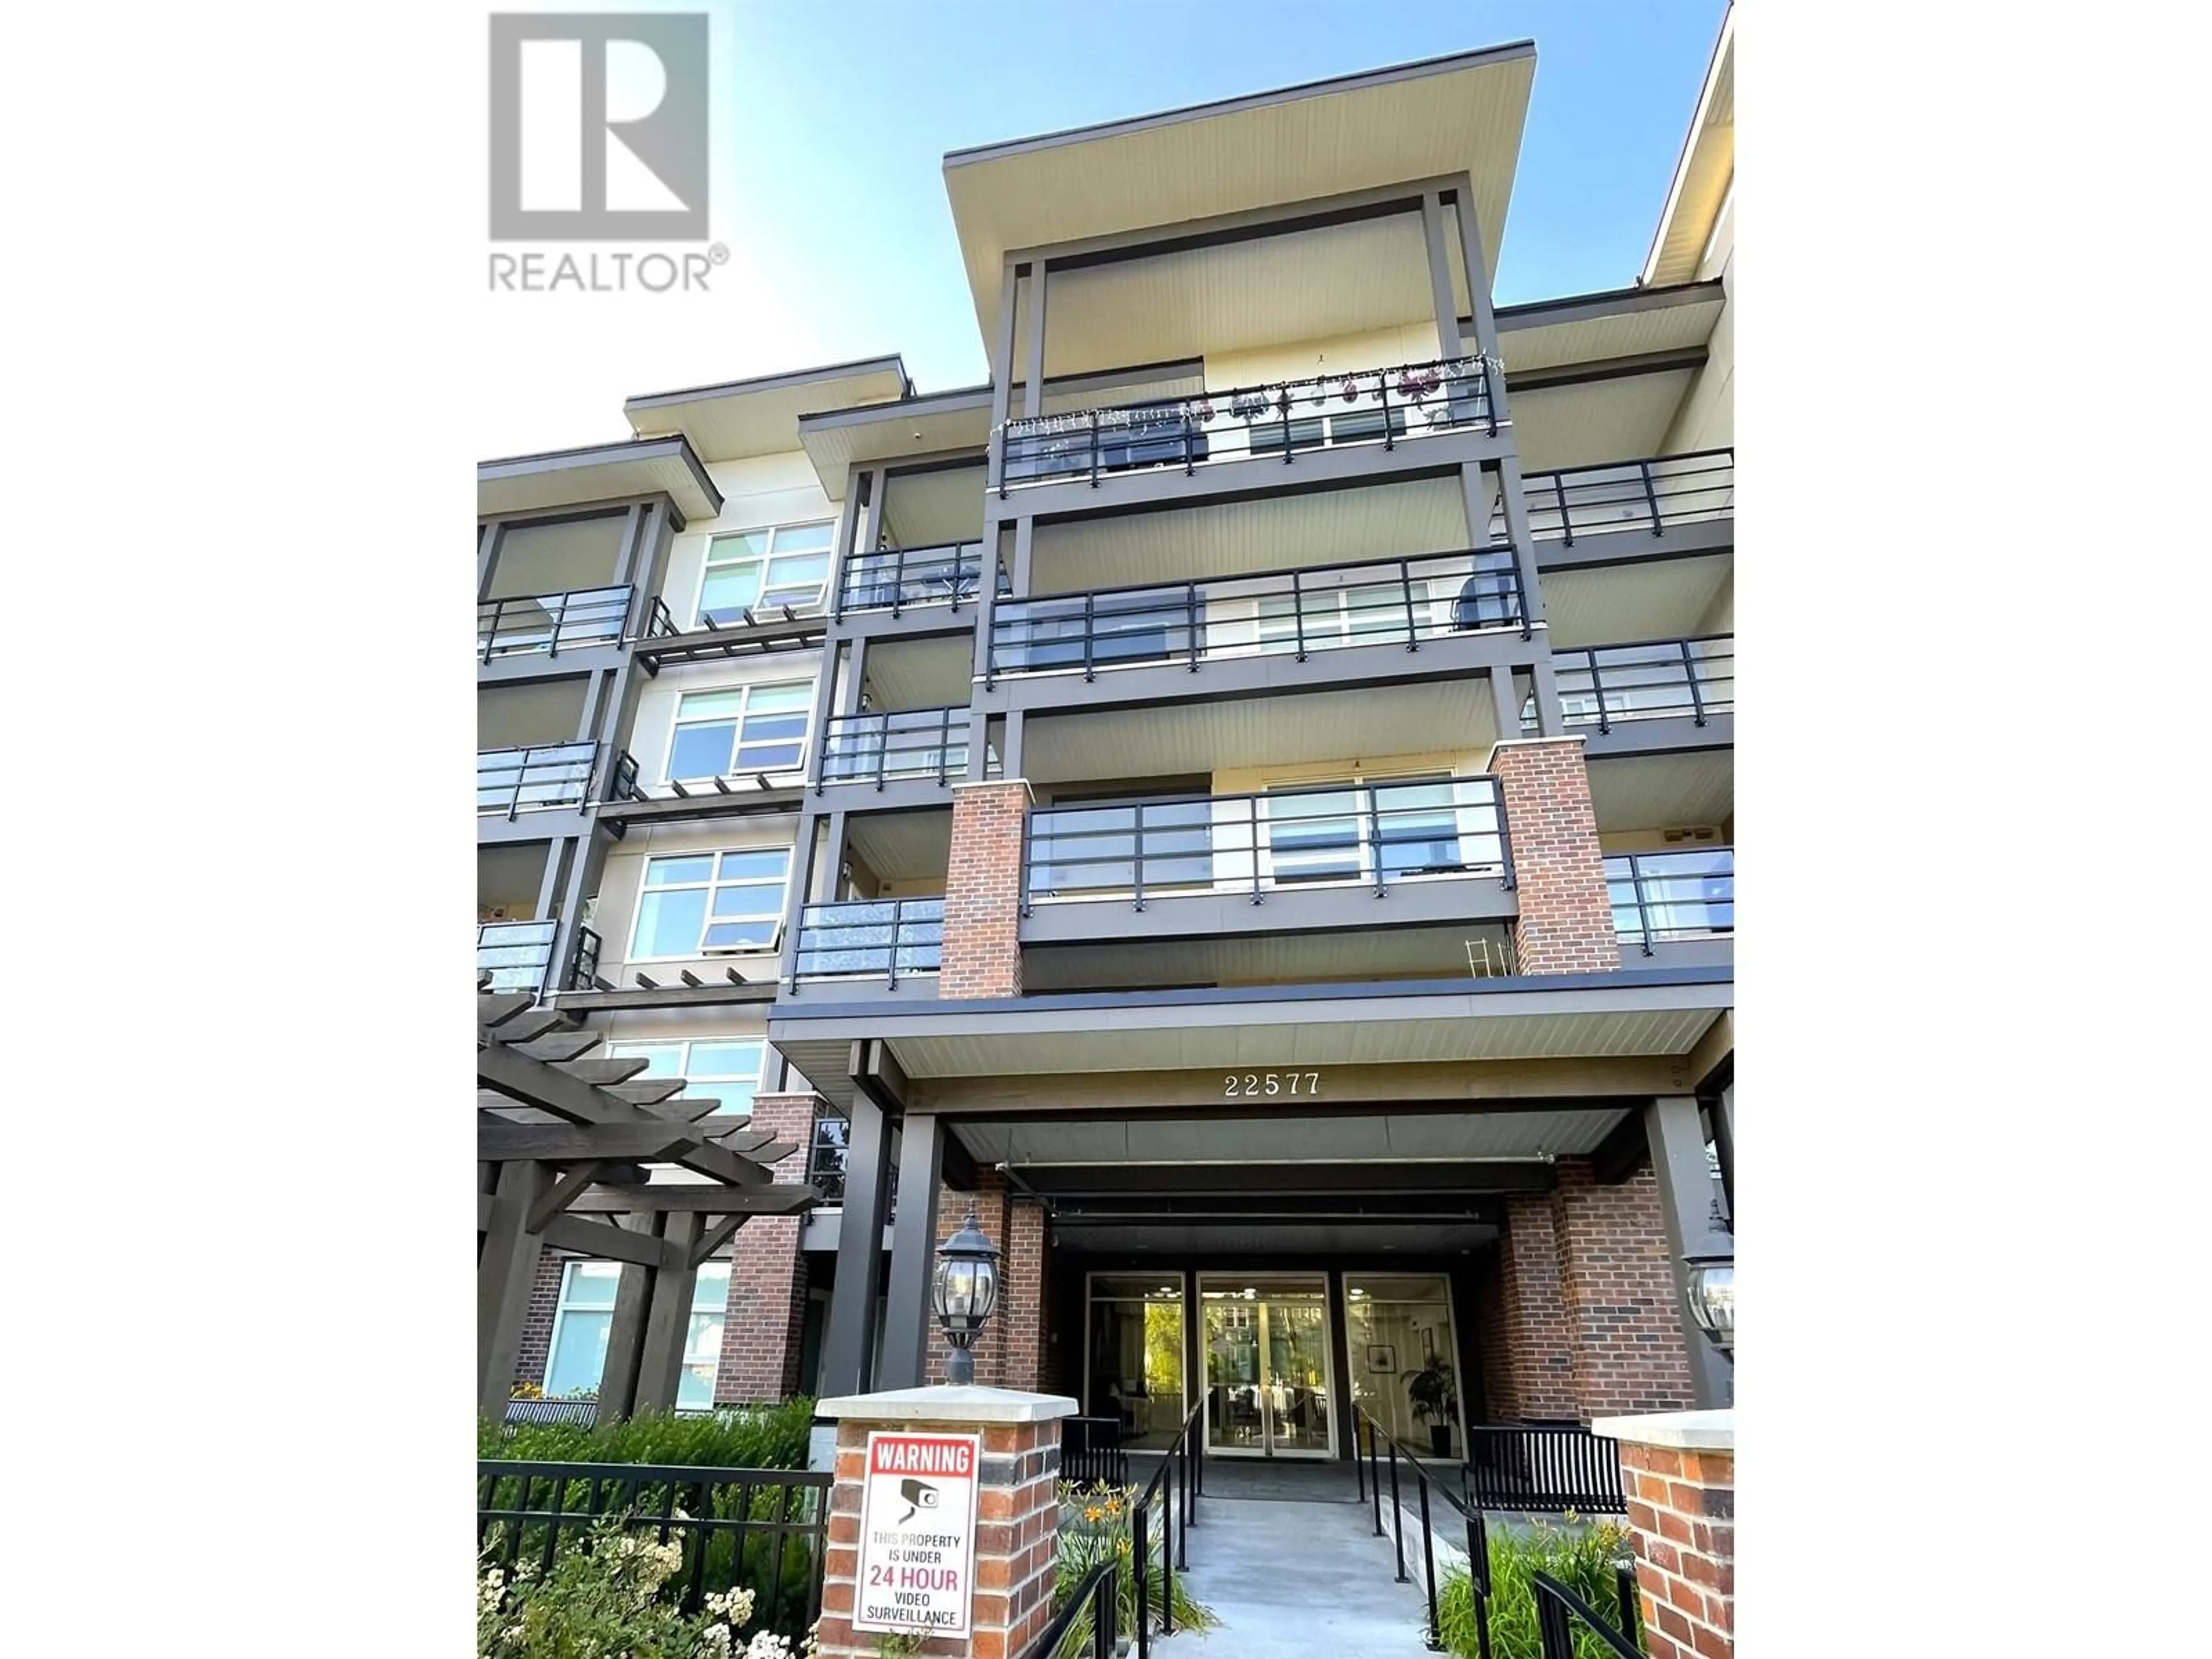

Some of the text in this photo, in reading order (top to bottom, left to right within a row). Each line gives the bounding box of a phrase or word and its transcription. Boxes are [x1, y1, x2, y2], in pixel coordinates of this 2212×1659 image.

[1225, 1073, 1319, 1096] 22577
[876, 1442, 970, 1472] WARNING
[873, 1531, 961, 1548] THIS PROPERTY
[889, 1549, 941, 1563] IS UNDER
[869, 1565, 958, 1592] 24 HOUR
[895, 1592, 930, 1607] VIDEO
[867, 1605, 958, 1626] SURVEILLANCE
